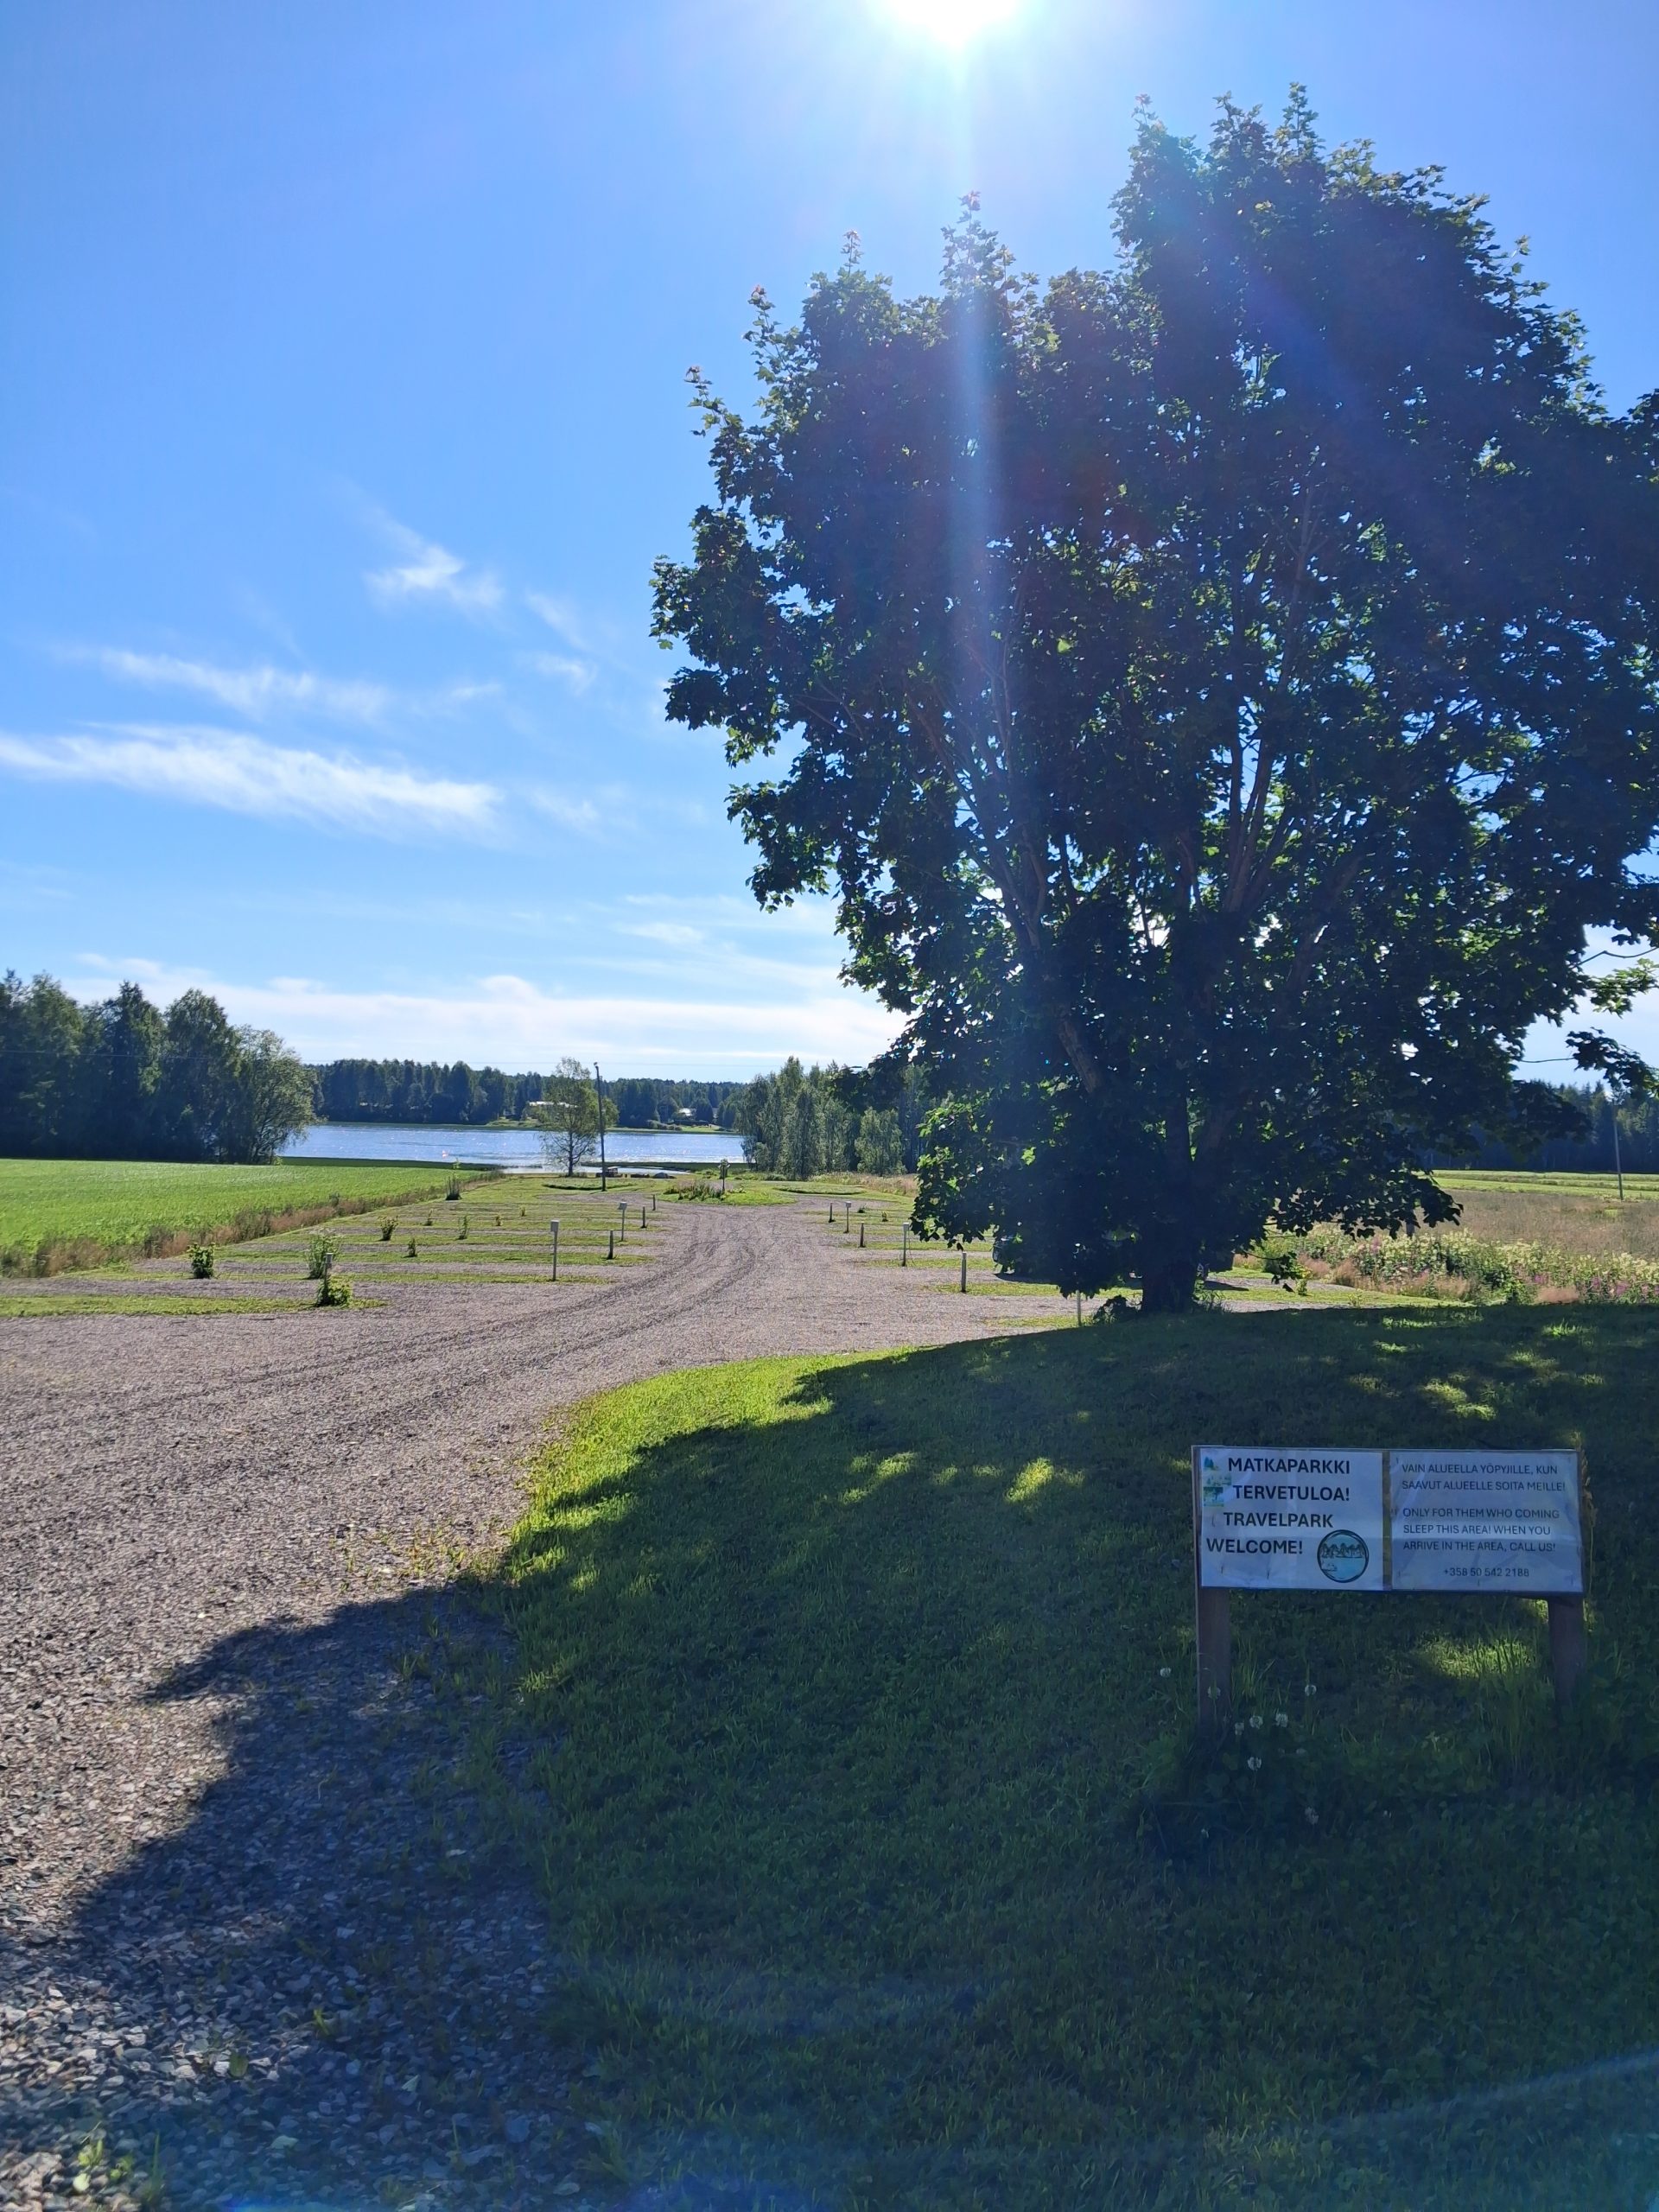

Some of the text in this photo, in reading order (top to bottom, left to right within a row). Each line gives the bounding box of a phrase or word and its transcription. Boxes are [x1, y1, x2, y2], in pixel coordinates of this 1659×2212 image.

[1229, 1458, 1350, 1474] MATKAPARKKI
[1402, 1465, 1425, 1473] VAIN
[1427, 1465, 1478, 1473] ALUEELLA
[1536, 1465, 1557, 1474] KUN
[1402, 1481, 1565, 1491] SAAVUT ALUEELLE SOITA MEILLE!
[1233, 1485, 1350, 1501] TERVETULOA!
[1403, 1508, 1560, 1518] ONLY FOR THEM WHO COMING
[1224, 1512, 1333, 1528] TRAVELPARK
[1403, 1524, 1550, 1535] SLEEP THIS AREA! WHEN YOU
[1207, 1539, 1303, 1554] WELCOME!
[1403, 1541, 1555, 1552] ARRIVE IN THE AREA, CALL US!
